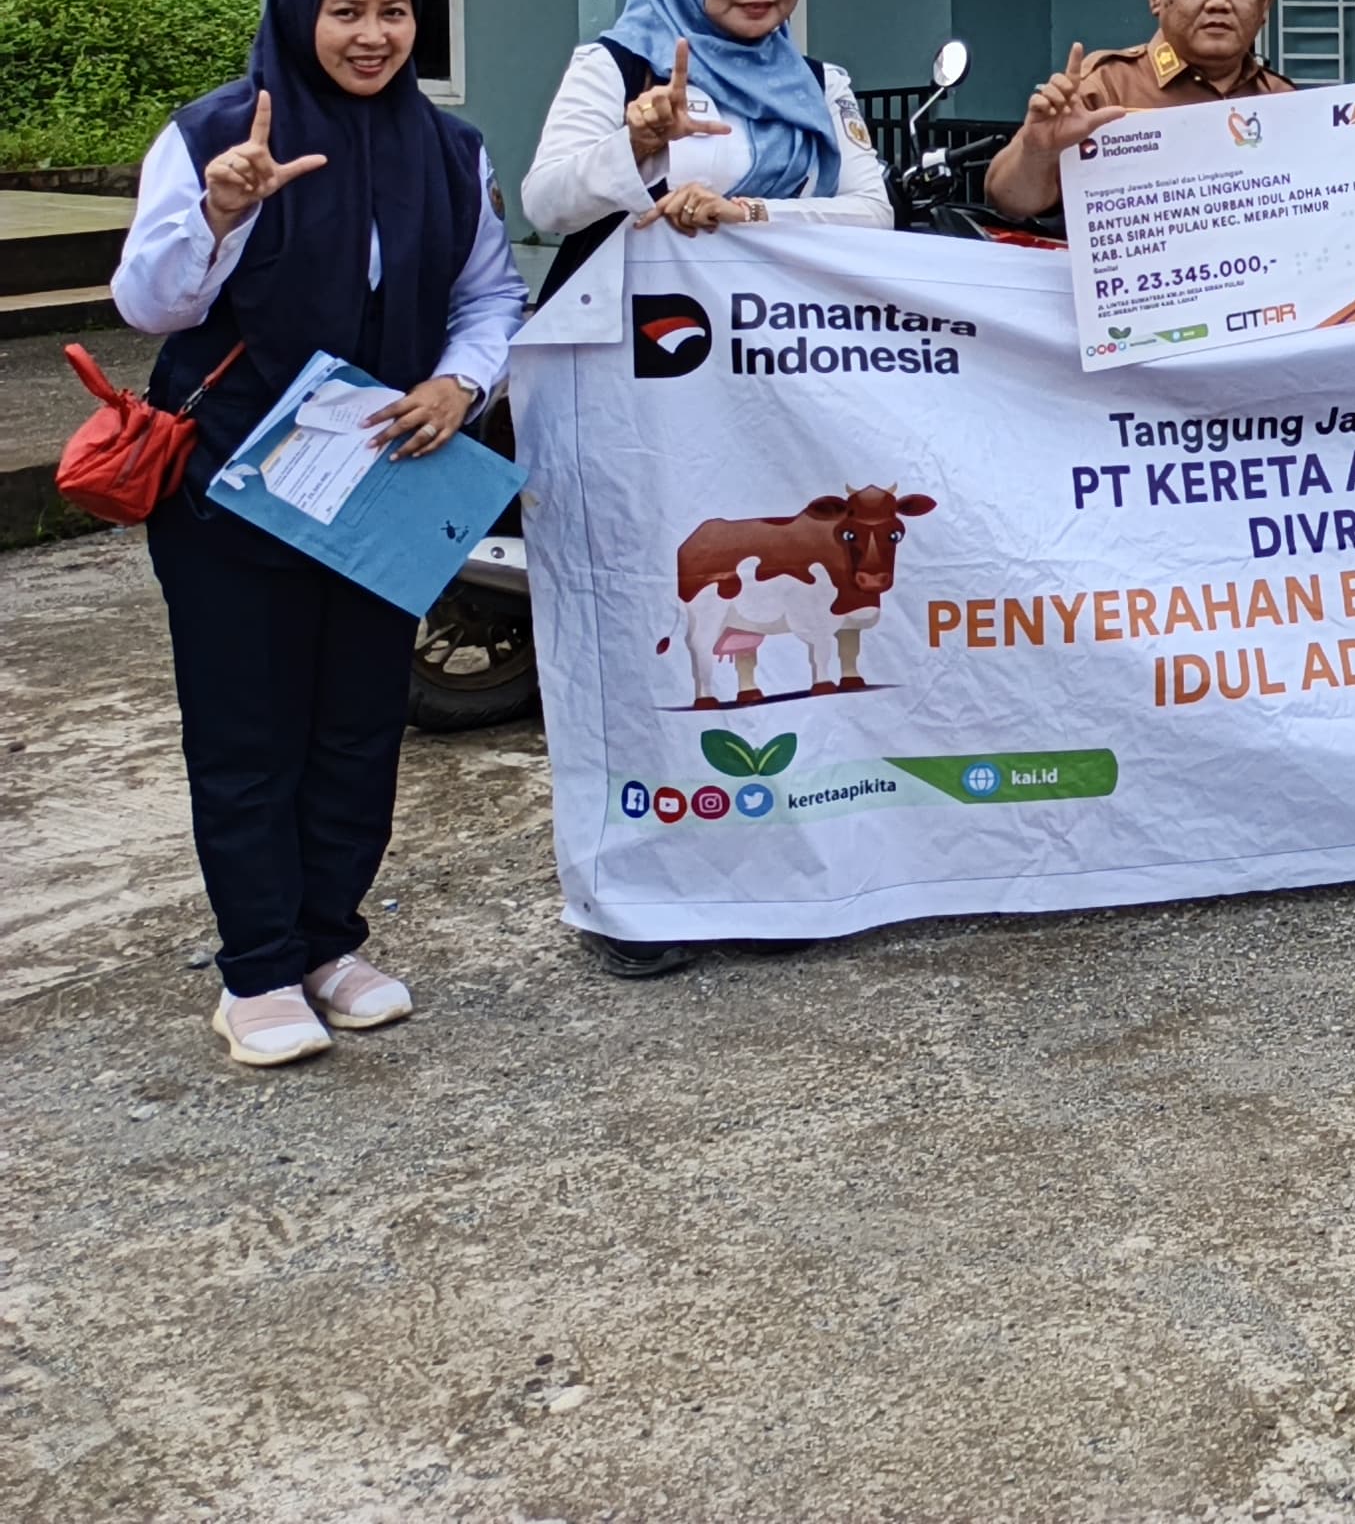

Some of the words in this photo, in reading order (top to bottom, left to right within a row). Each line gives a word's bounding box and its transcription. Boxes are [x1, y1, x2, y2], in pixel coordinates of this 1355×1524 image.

[1101, 130, 1162, 146] Danantara
[1102, 141, 1160, 158] Indonesia
[1086, 192, 1159, 215] PROGRAM
[1163, 187, 1196, 203] BINA
[1199, 173, 1291, 198] LINGKUNGAN
[1088, 213, 1150, 233] BANTUAN
[1154, 205, 1201, 223] HEWAN
[1203, 197, 1255, 216] QURBAN
[1257, 191, 1286, 207] IDUL
[1288, 186, 1323, 202] ADHA
[1325, 182, 1351, 197] 1447
[1089, 232, 1124, 248] DESA
[1127, 226, 1165, 243] SIRAH
[1168, 219, 1209, 236] PULAU
[1211, 214, 1241, 229] KEC.
[1243, 206, 1289, 225] MERAPI
[1292, 199, 1331, 217] TIMUR
[1091, 248, 1123, 264] KAB.
[1126, 241, 1168, 258] LAHAT
[1095, 277, 1130, 299] RP.
[1137, 254, 1278, 292] 23.345.000,-
[730, 291, 978, 337] Danantara
[1226, 303, 1297, 332] CITAR
[731, 337, 961, 376] Indonesia
[1109, 411, 1305, 455] Tanggung
[1072, 464, 1132, 510] PT
[1146, 453, 1334, 507] KERETA
[926, 572, 1325, 649] PENYERAHAN
[1152, 646, 1287, 709] IDUL
[787, 777, 897, 810] keretaapikita
[1010, 766, 1058, 787] kai.id
